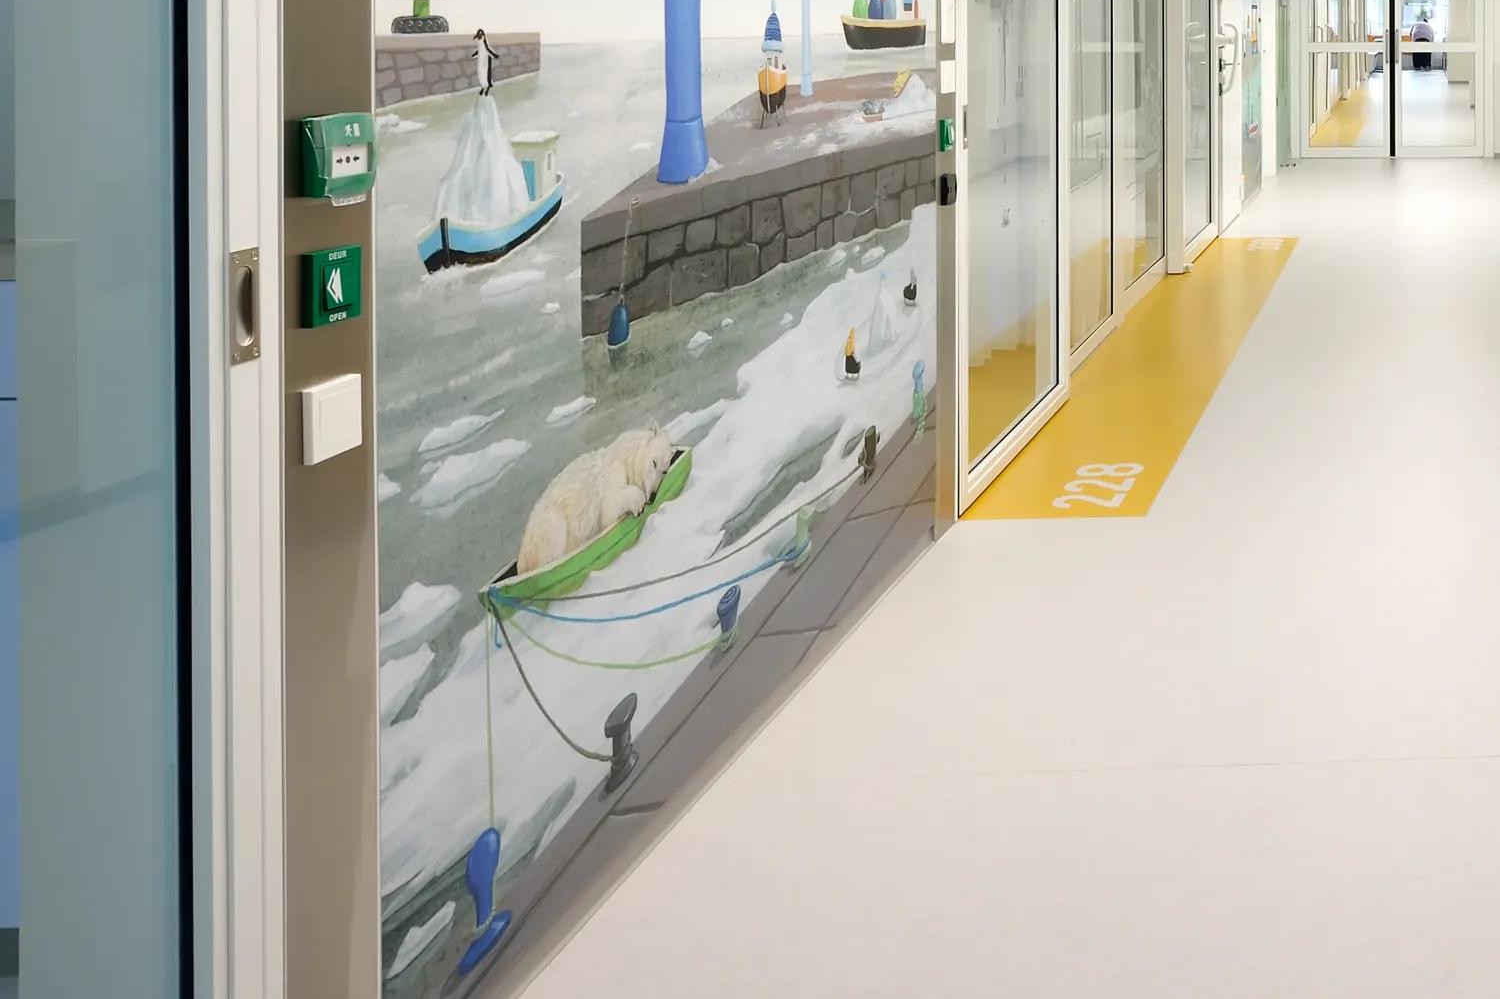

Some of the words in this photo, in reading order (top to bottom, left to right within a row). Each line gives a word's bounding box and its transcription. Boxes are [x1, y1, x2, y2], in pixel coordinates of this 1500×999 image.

[328, 250, 347, 261] DEUR
[328, 310, 347, 322] OPEN
[1052, 463, 1145, 509] 228
